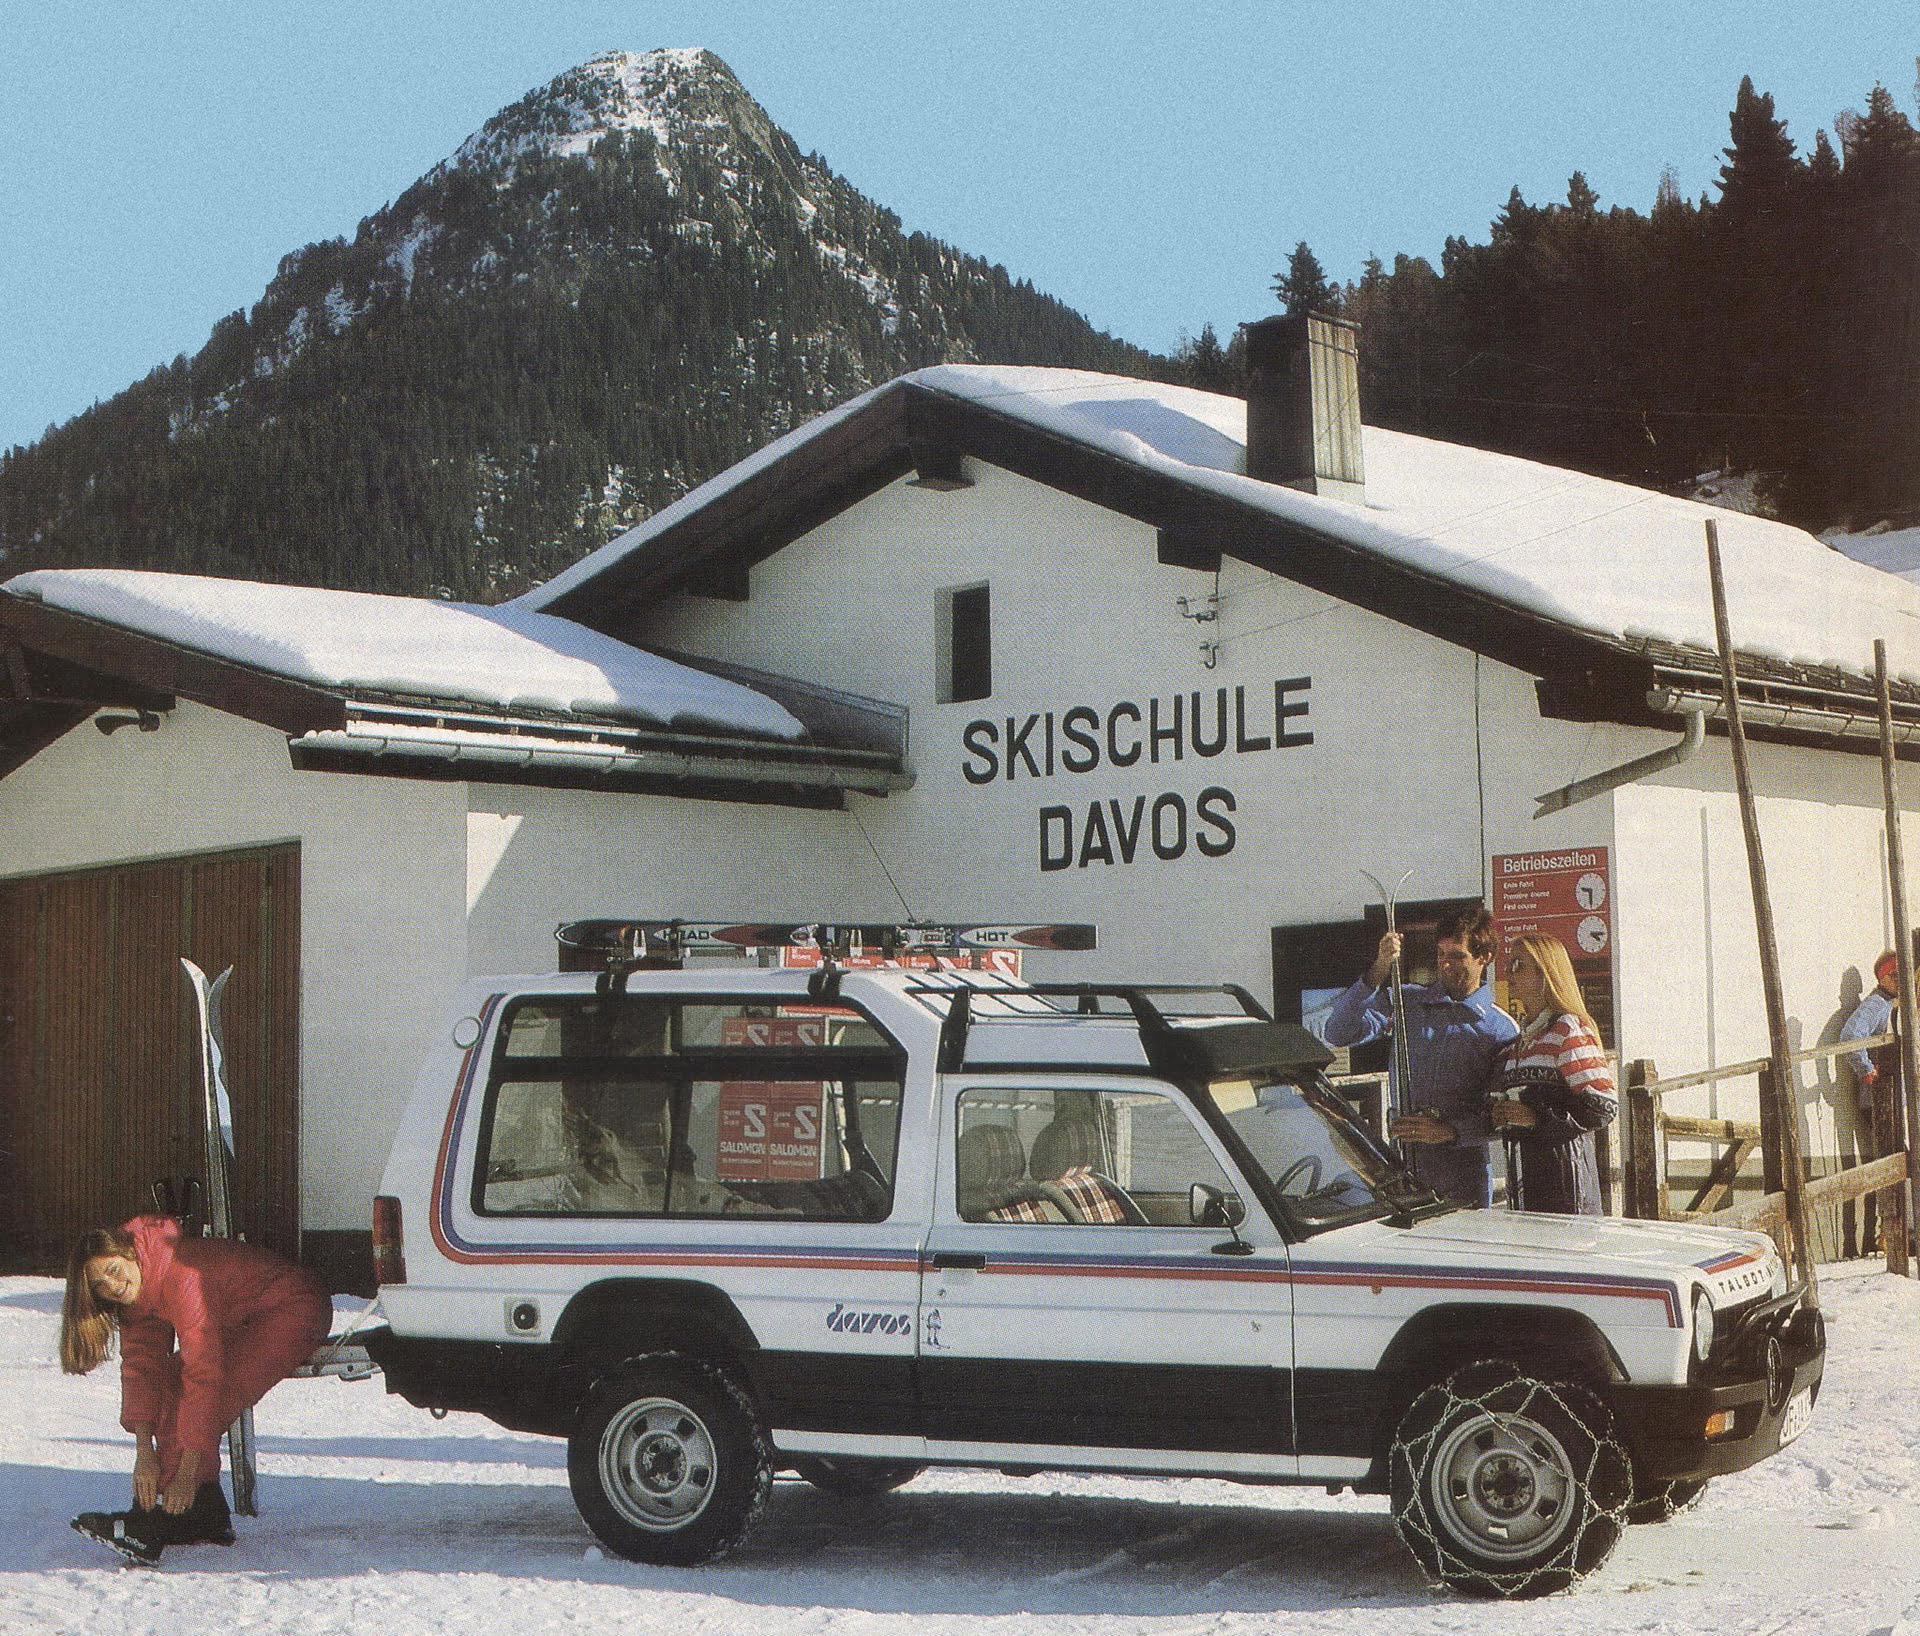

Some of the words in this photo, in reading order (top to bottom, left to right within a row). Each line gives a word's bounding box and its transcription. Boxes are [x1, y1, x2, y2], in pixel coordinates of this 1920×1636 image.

[962, 676, 1314, 785] SKISCHULE
[1039, 786, 1237, 872] DAVOS
[1503, 852, 1596, 873] Betriebszeiten
[663, 930, 710, 940] HAD
[976, 931, 1009, 942] HOT
[719, 1141, 766, 1155] SALOMON
[768, 1143, 818, 1157] SALOMON
[1718, 1269, 1765, 1294] TALBOT
[826, 1303, 911, 1335] davos
